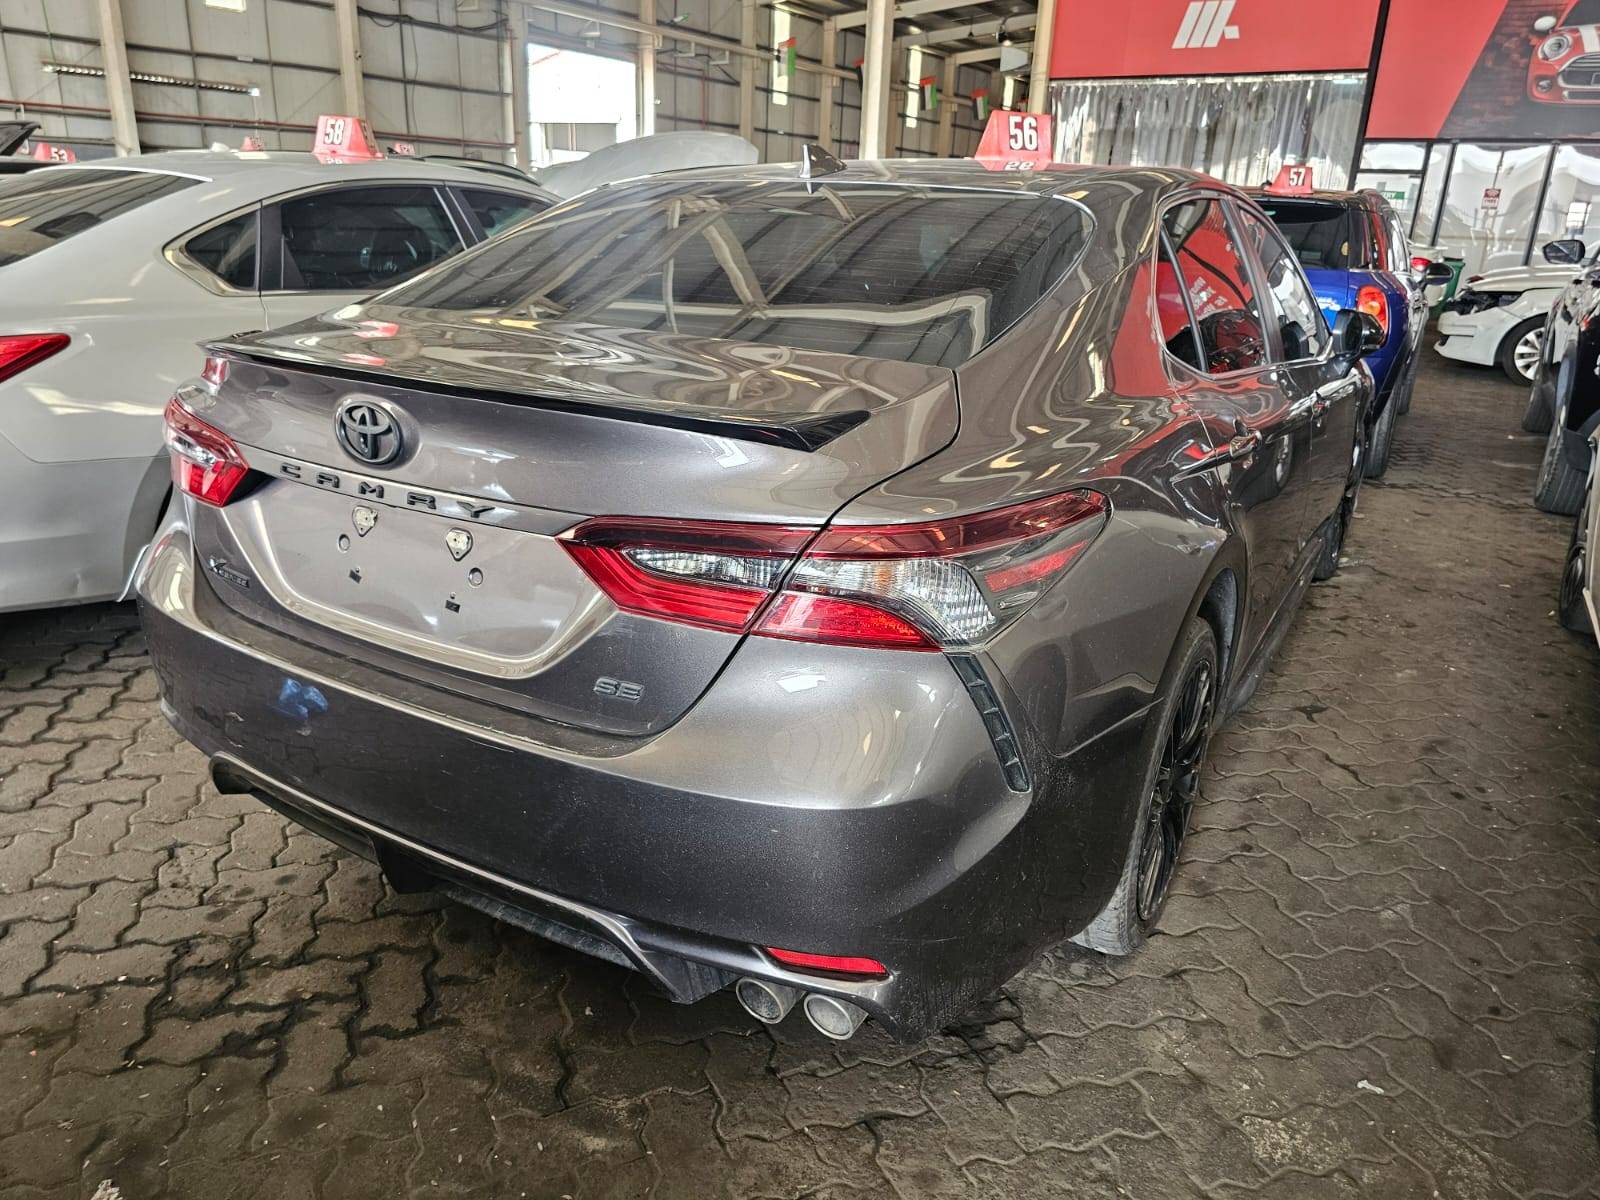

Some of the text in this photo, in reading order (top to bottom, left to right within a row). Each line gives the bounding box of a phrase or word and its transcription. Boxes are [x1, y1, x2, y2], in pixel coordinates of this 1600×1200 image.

[323, 119, 345, 145] 58
[1008, 115, 1039, 151] 56
[1289, 167, 1306, 187] 57
[280, 462, 495, 518] CAMRY
[593, 676, 644, 701] SE
